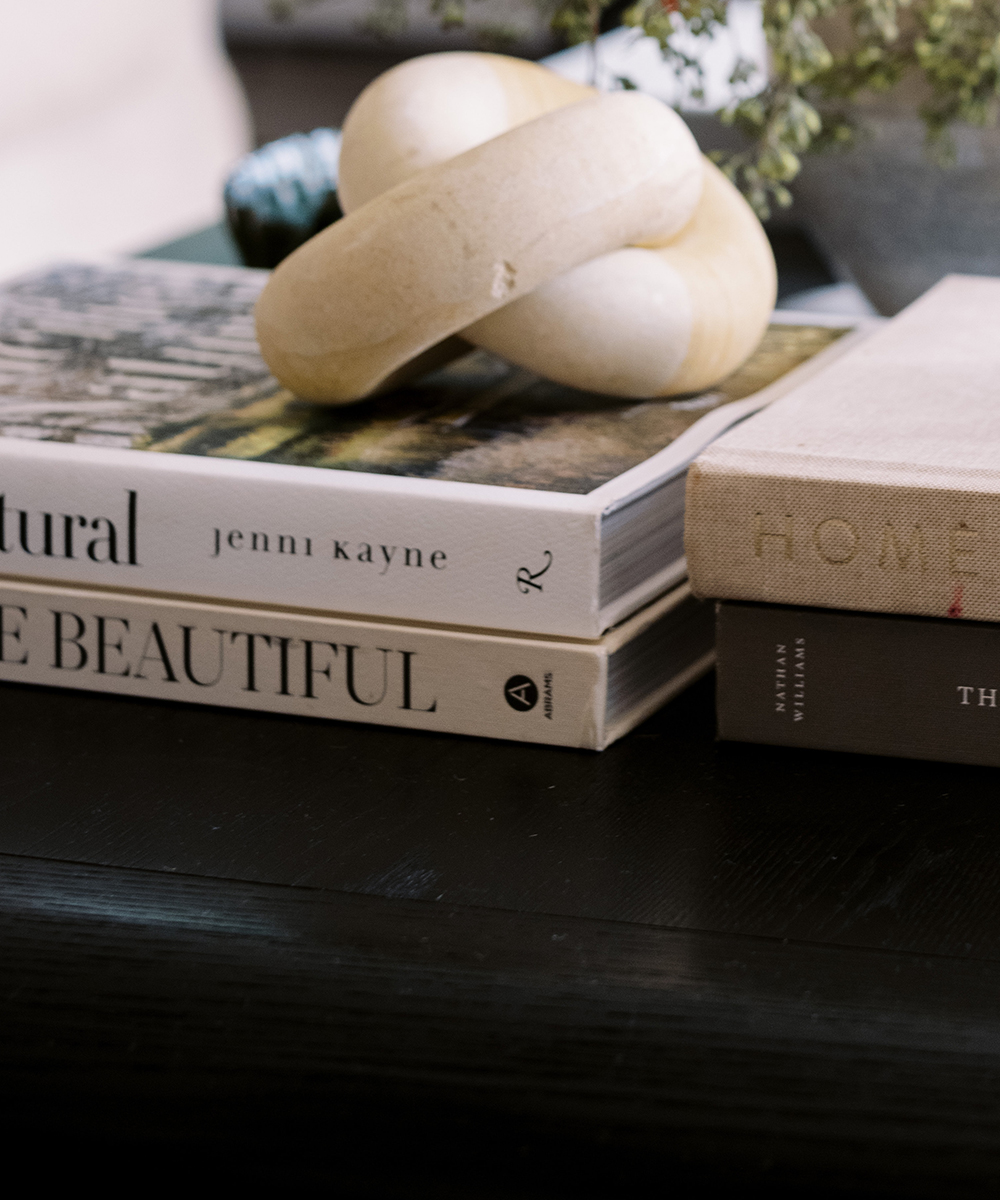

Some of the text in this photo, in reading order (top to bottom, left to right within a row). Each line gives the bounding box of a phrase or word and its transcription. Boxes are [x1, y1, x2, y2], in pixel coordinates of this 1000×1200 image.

[209, 526, 314, 558] jenni
[49, 608, 438, 714] BEAUTIFUL
[543, 671, 554, 721] ABRAMS
[775, 643, 787, 713] NATHAN
[793, 636, 805, 722] WILLIAMS
